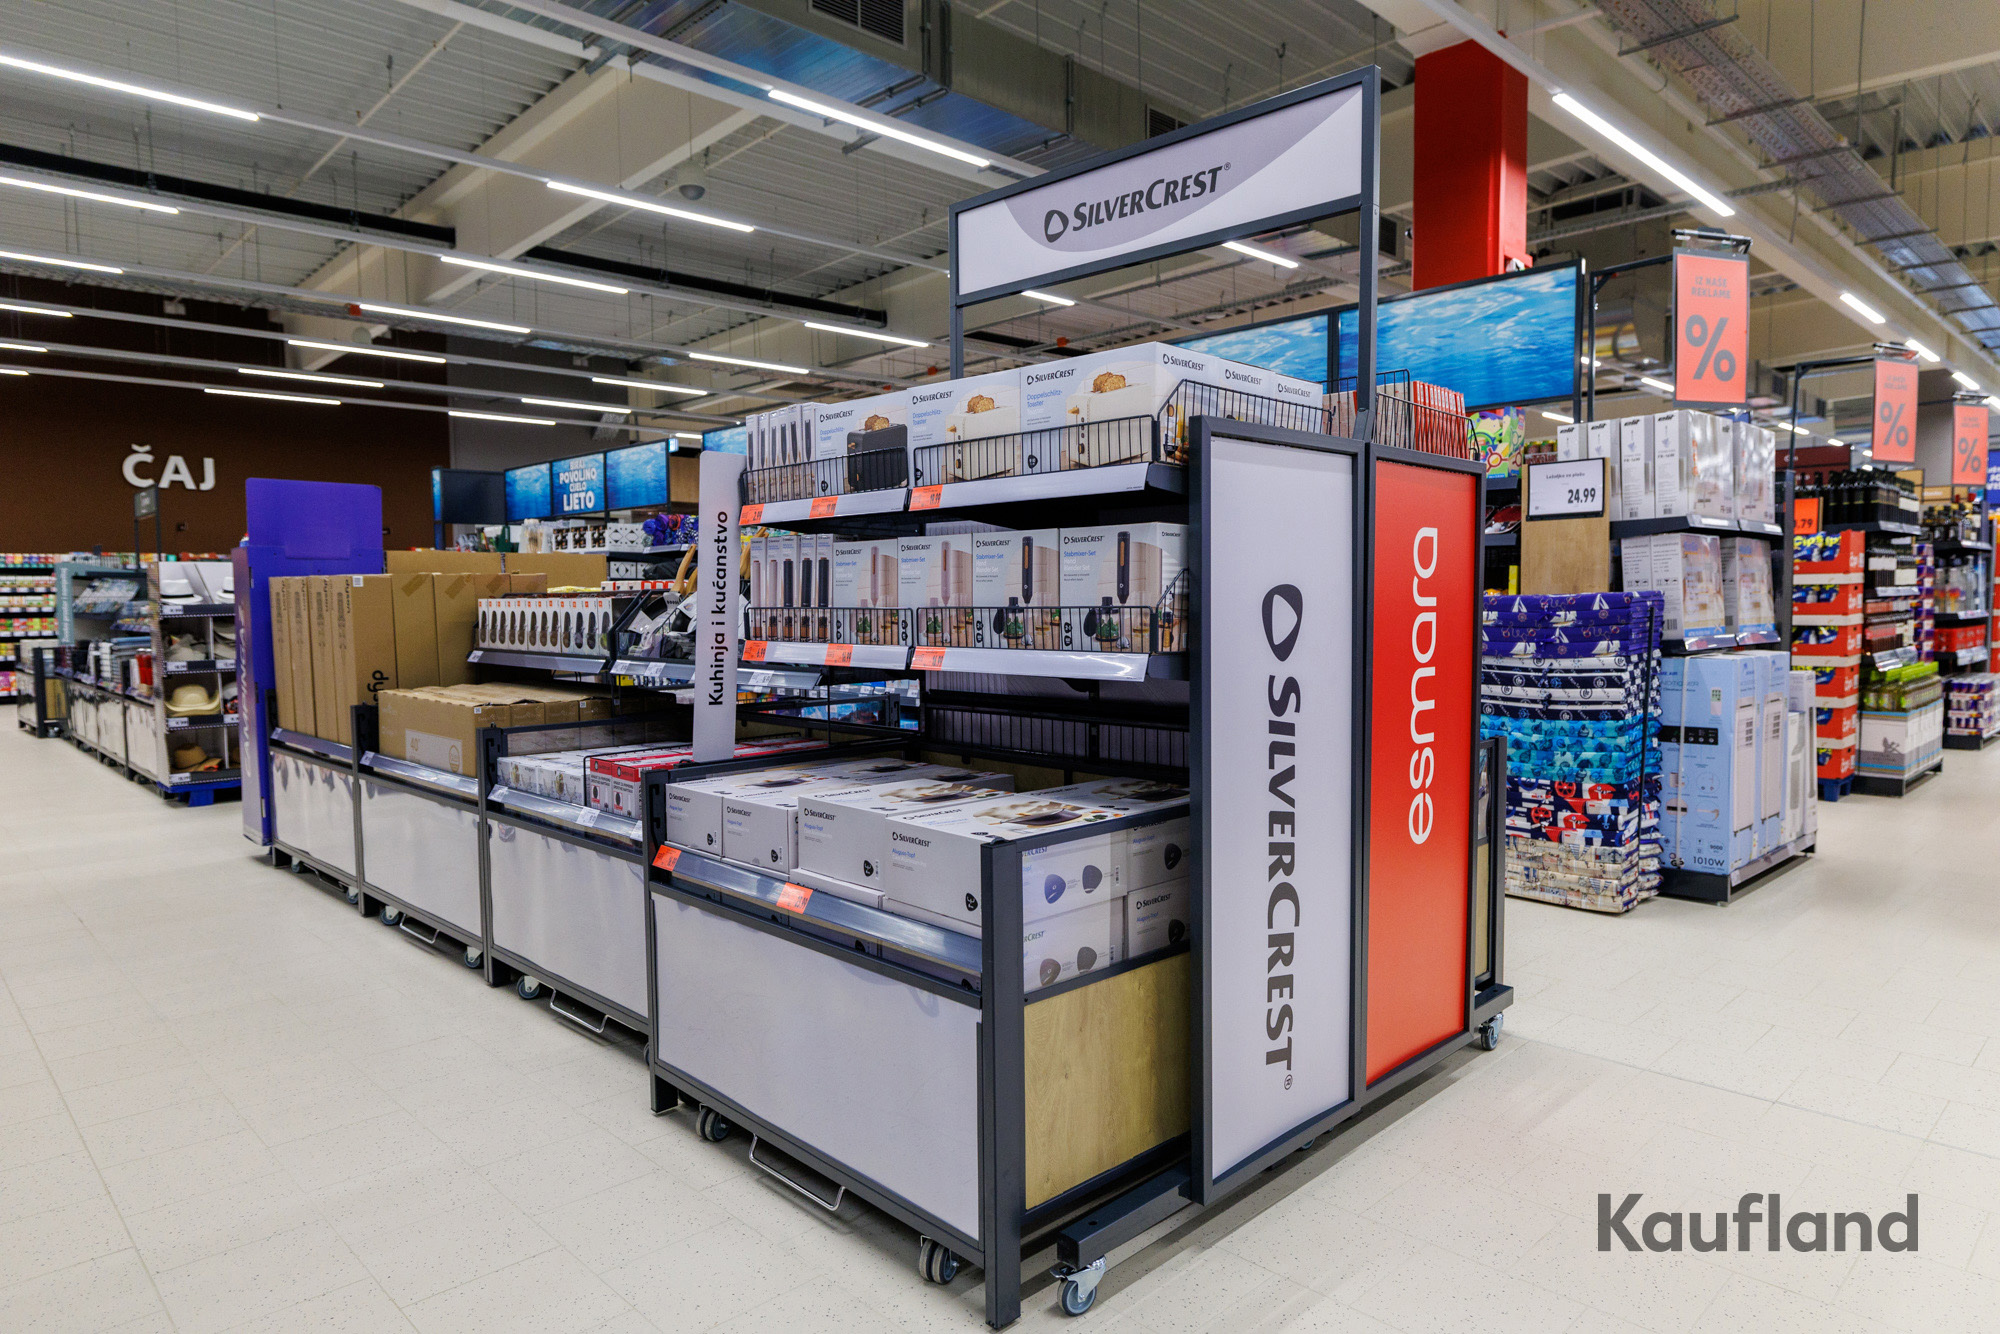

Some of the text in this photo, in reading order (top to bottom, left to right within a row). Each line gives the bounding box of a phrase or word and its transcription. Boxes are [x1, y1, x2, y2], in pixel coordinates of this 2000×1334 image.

[122, 443, 216, 491] ČAJ
[563, 490, 595, 511] LJETO
[1567, 487, 1596, 504] 24.99
[711, 511, 728, 615] kućanstvo
[708, 631, 728, 706] Kuhinja
[1408, 526, 1438, 845] esmara
[898, 833, 932, 847] SILVERCREST
[1693, 856, 1725, 867] 1010W
